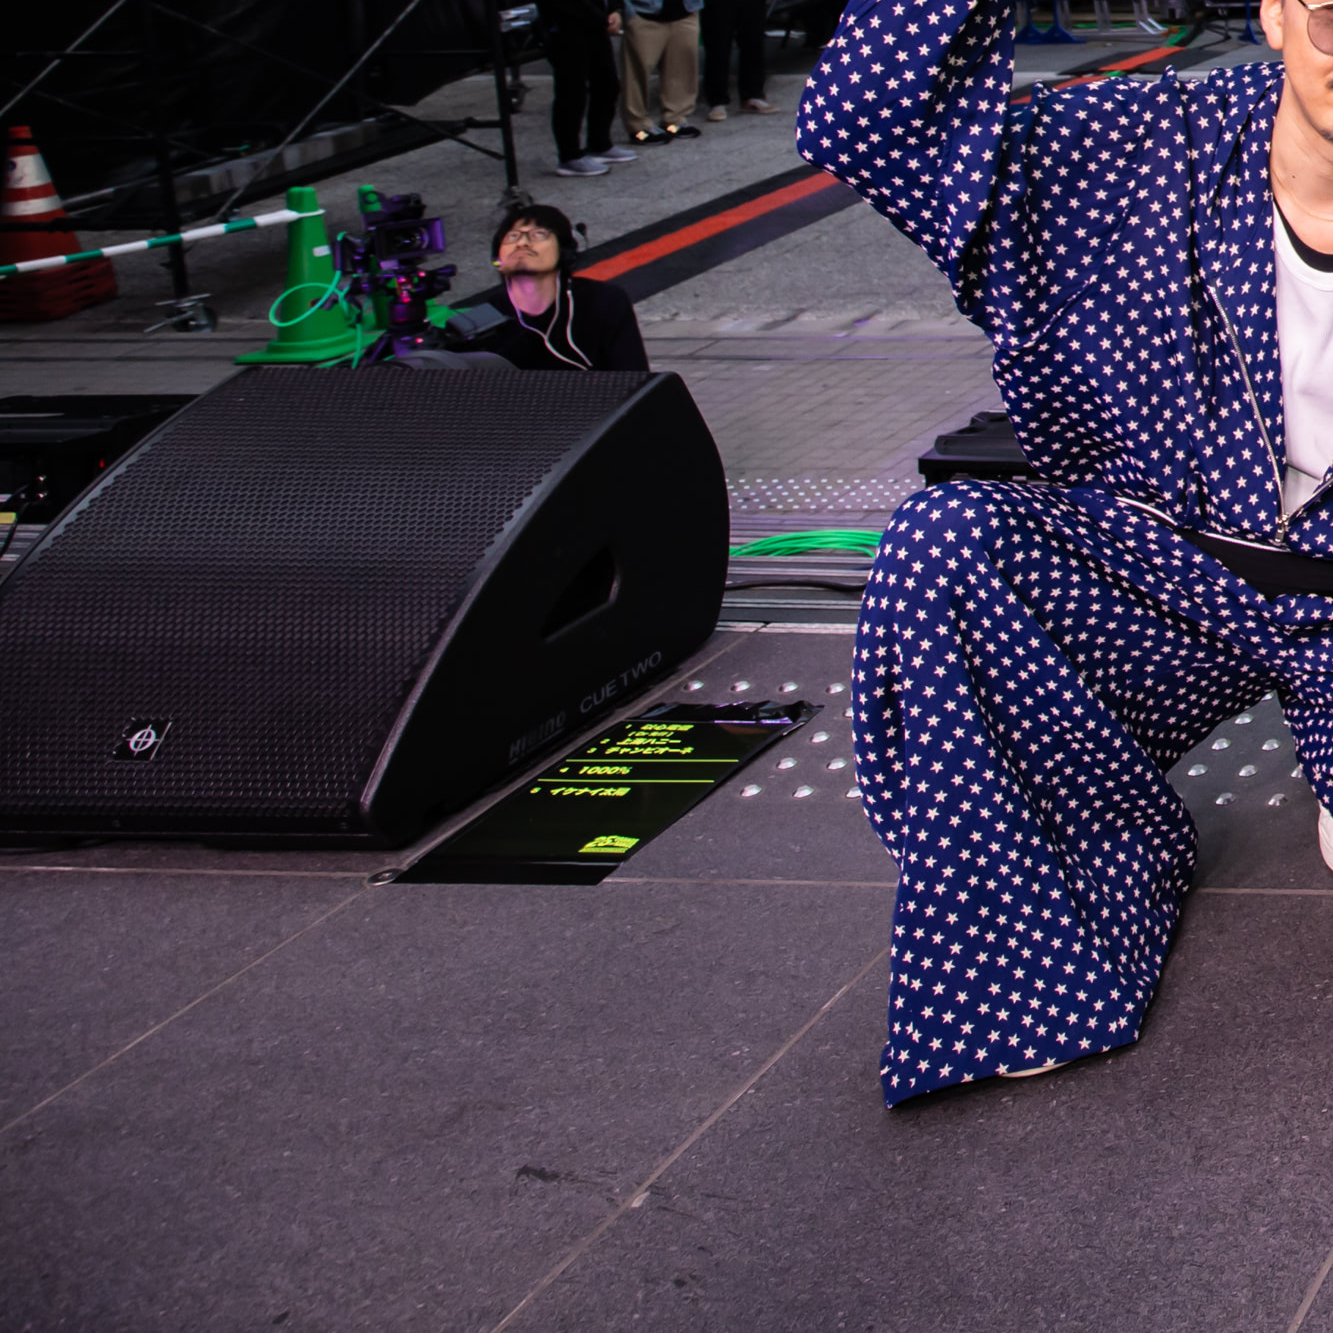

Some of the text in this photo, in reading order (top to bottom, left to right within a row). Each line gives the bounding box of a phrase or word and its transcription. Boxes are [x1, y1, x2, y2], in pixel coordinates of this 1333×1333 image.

[579, 680, 617, 714] CUE
[620, 651, 662, 687] TWO
[578, 766, 632, 774] 1000%
